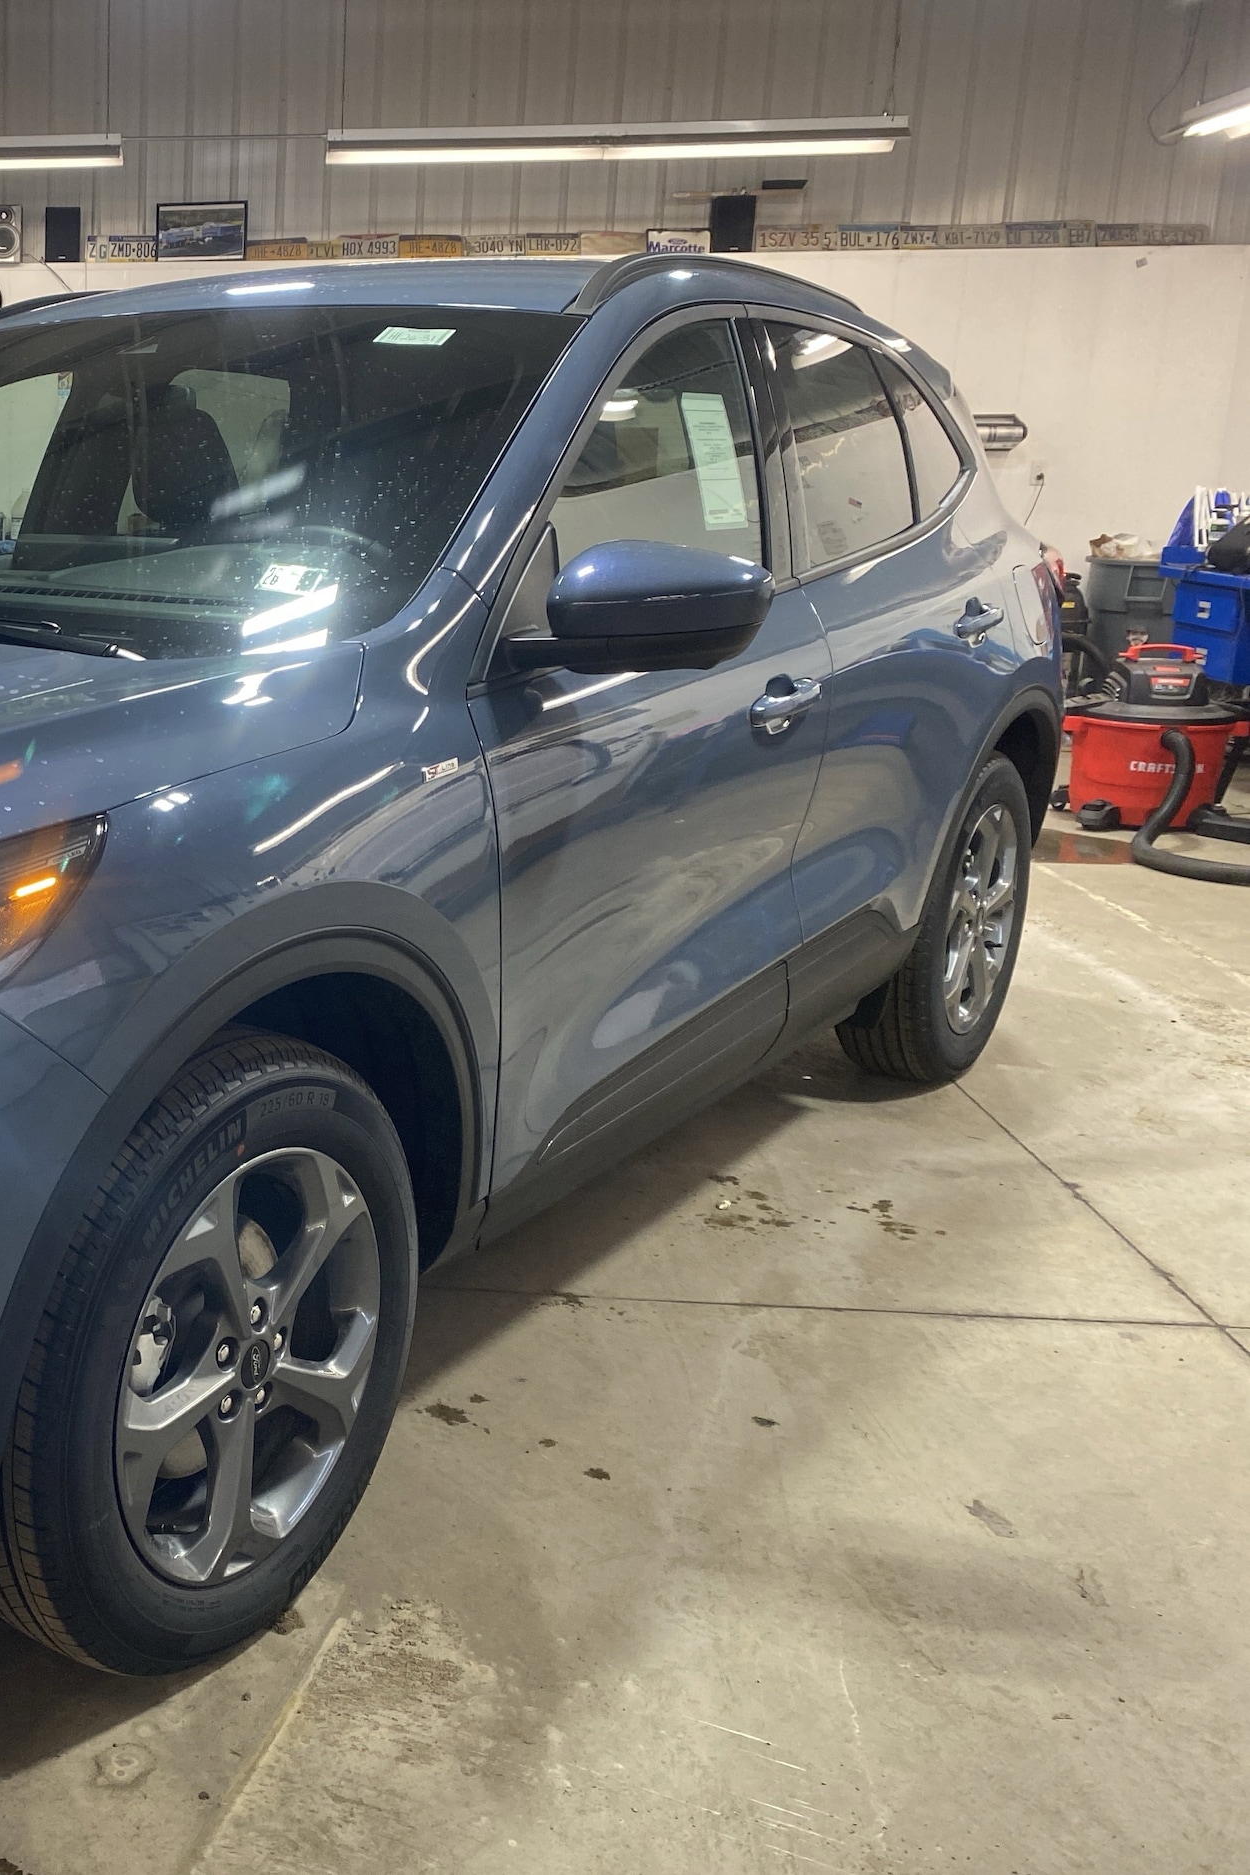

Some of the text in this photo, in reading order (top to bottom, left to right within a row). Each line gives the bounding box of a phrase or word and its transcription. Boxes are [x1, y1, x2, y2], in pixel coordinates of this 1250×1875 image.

[650, 240, 705, 253] Marcotte
[1129, 760, 1205, 774] CRAFTSN
[141, 1117, 244, 1251] MICHELIN
